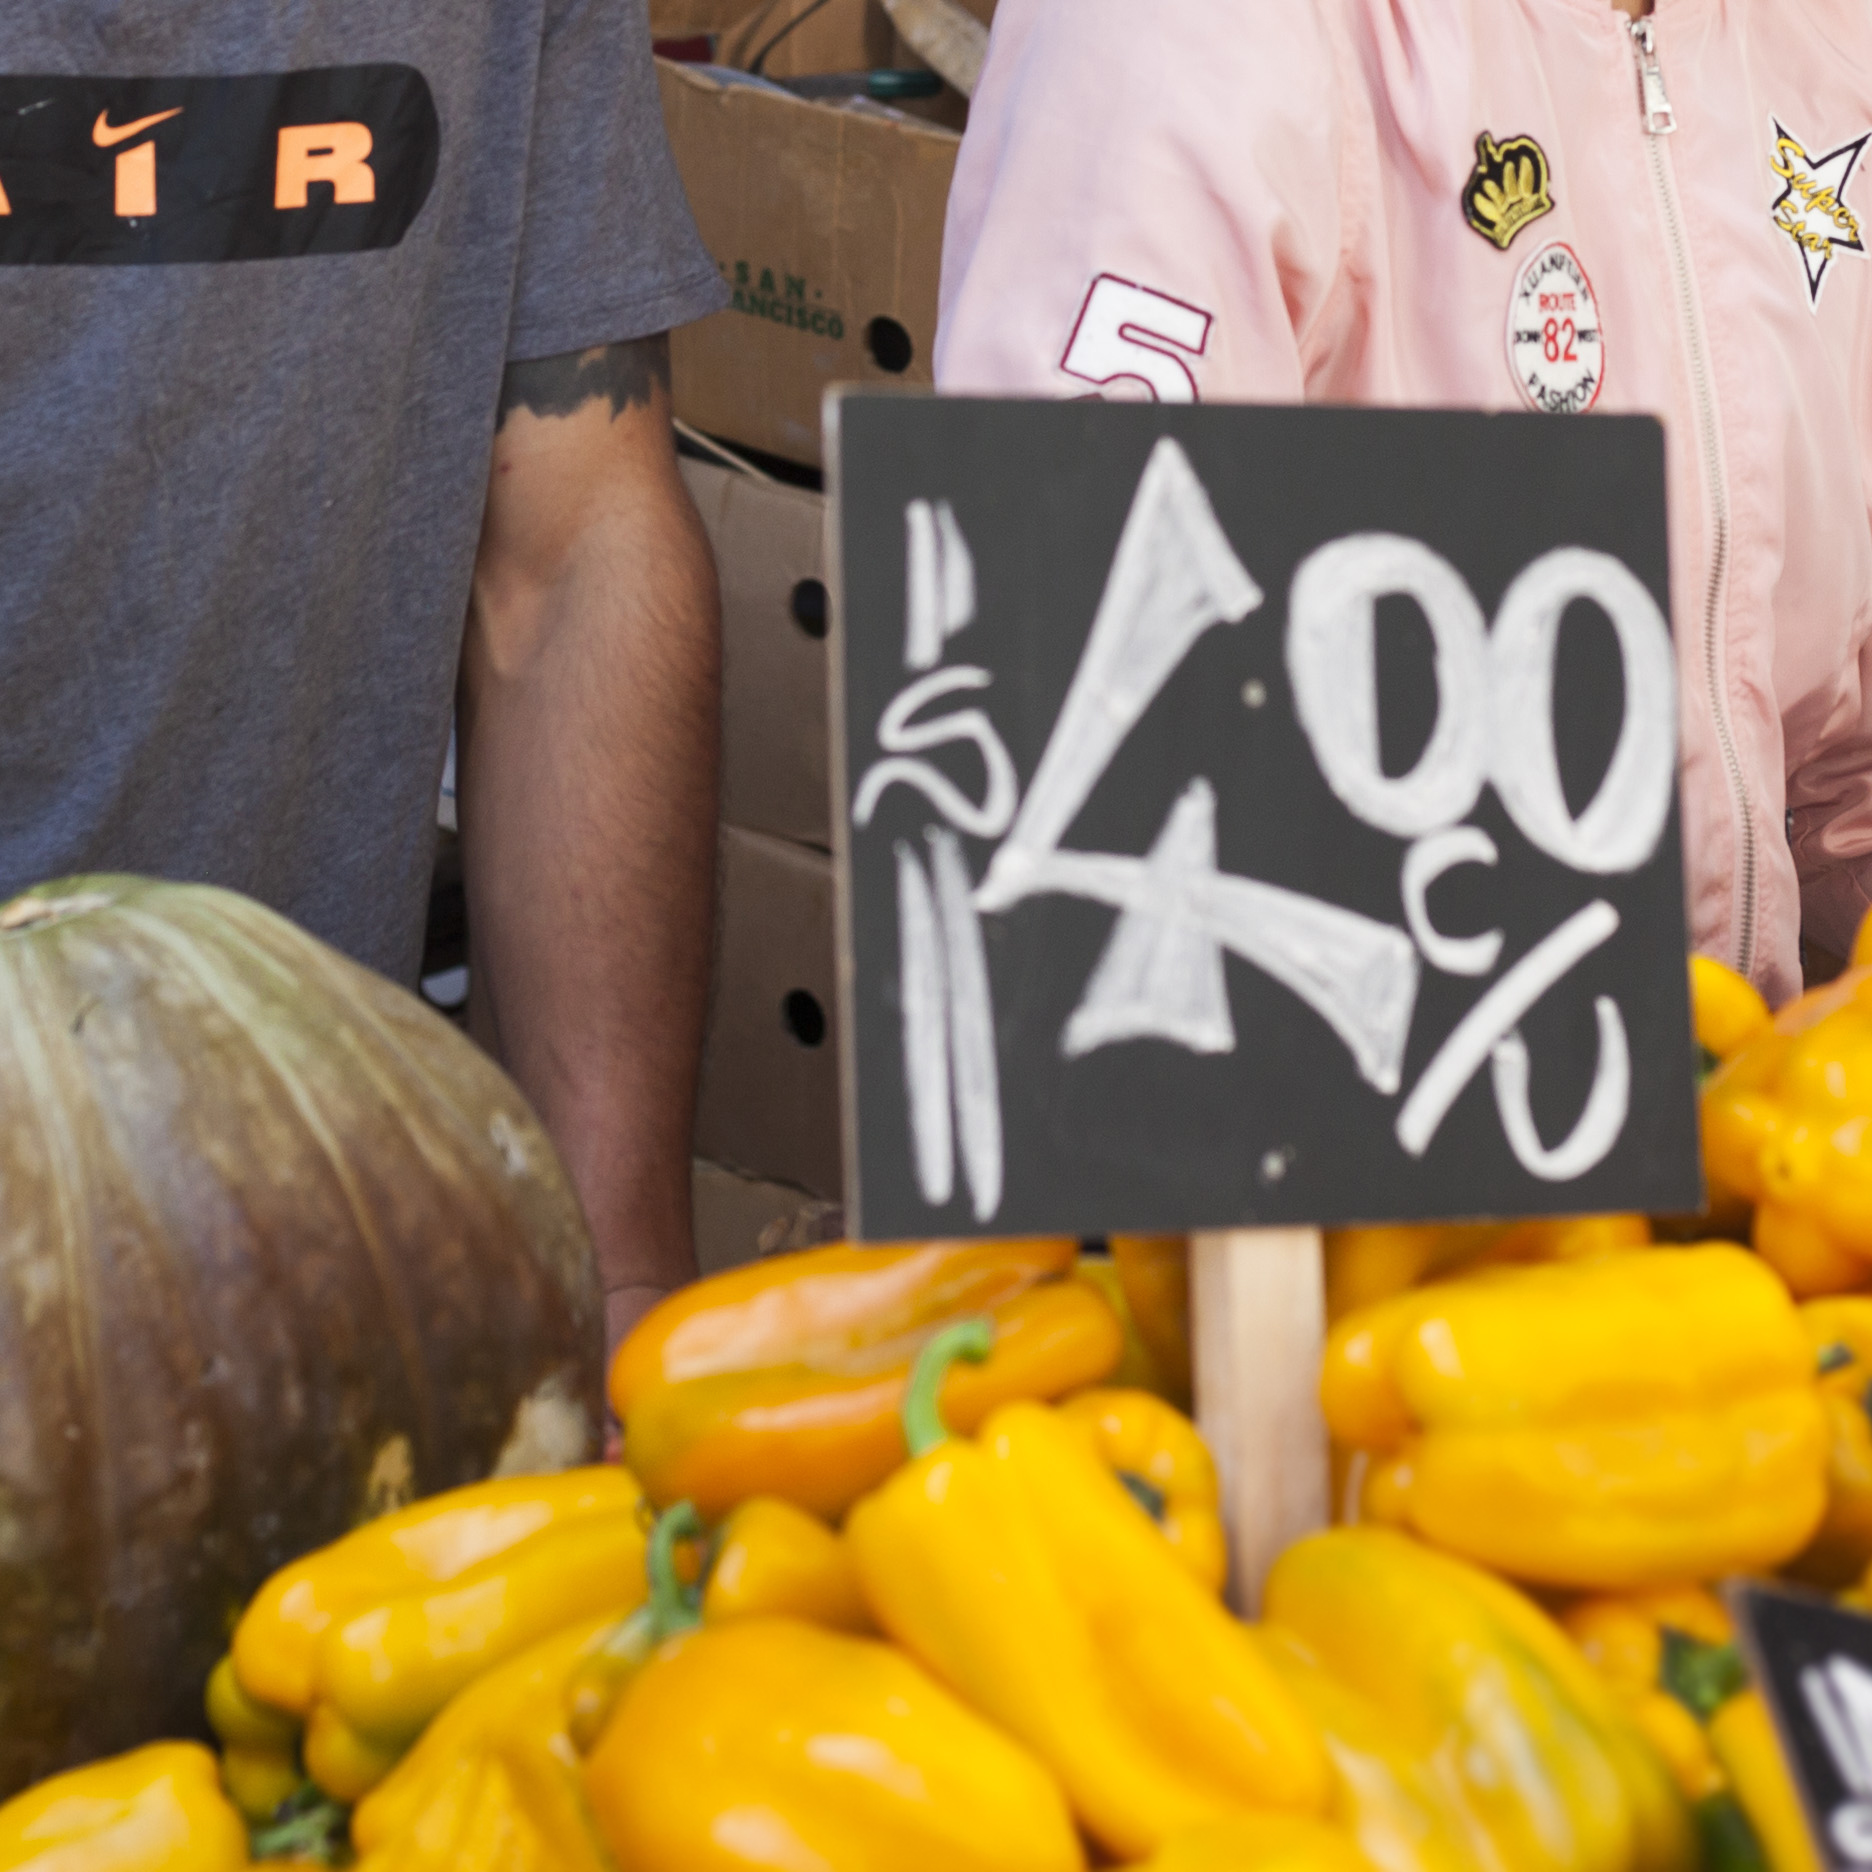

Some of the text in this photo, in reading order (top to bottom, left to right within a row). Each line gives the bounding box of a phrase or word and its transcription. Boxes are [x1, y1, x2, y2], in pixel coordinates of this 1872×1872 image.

[1770, 137, 1859, 242] Super
[1773, 199, 1832, 260] Star
[1538, 292, 1577, 313] ROUTE
[1543, 317, 1578, 363] 82
[1528, 370, 1595, 415] FASHION
